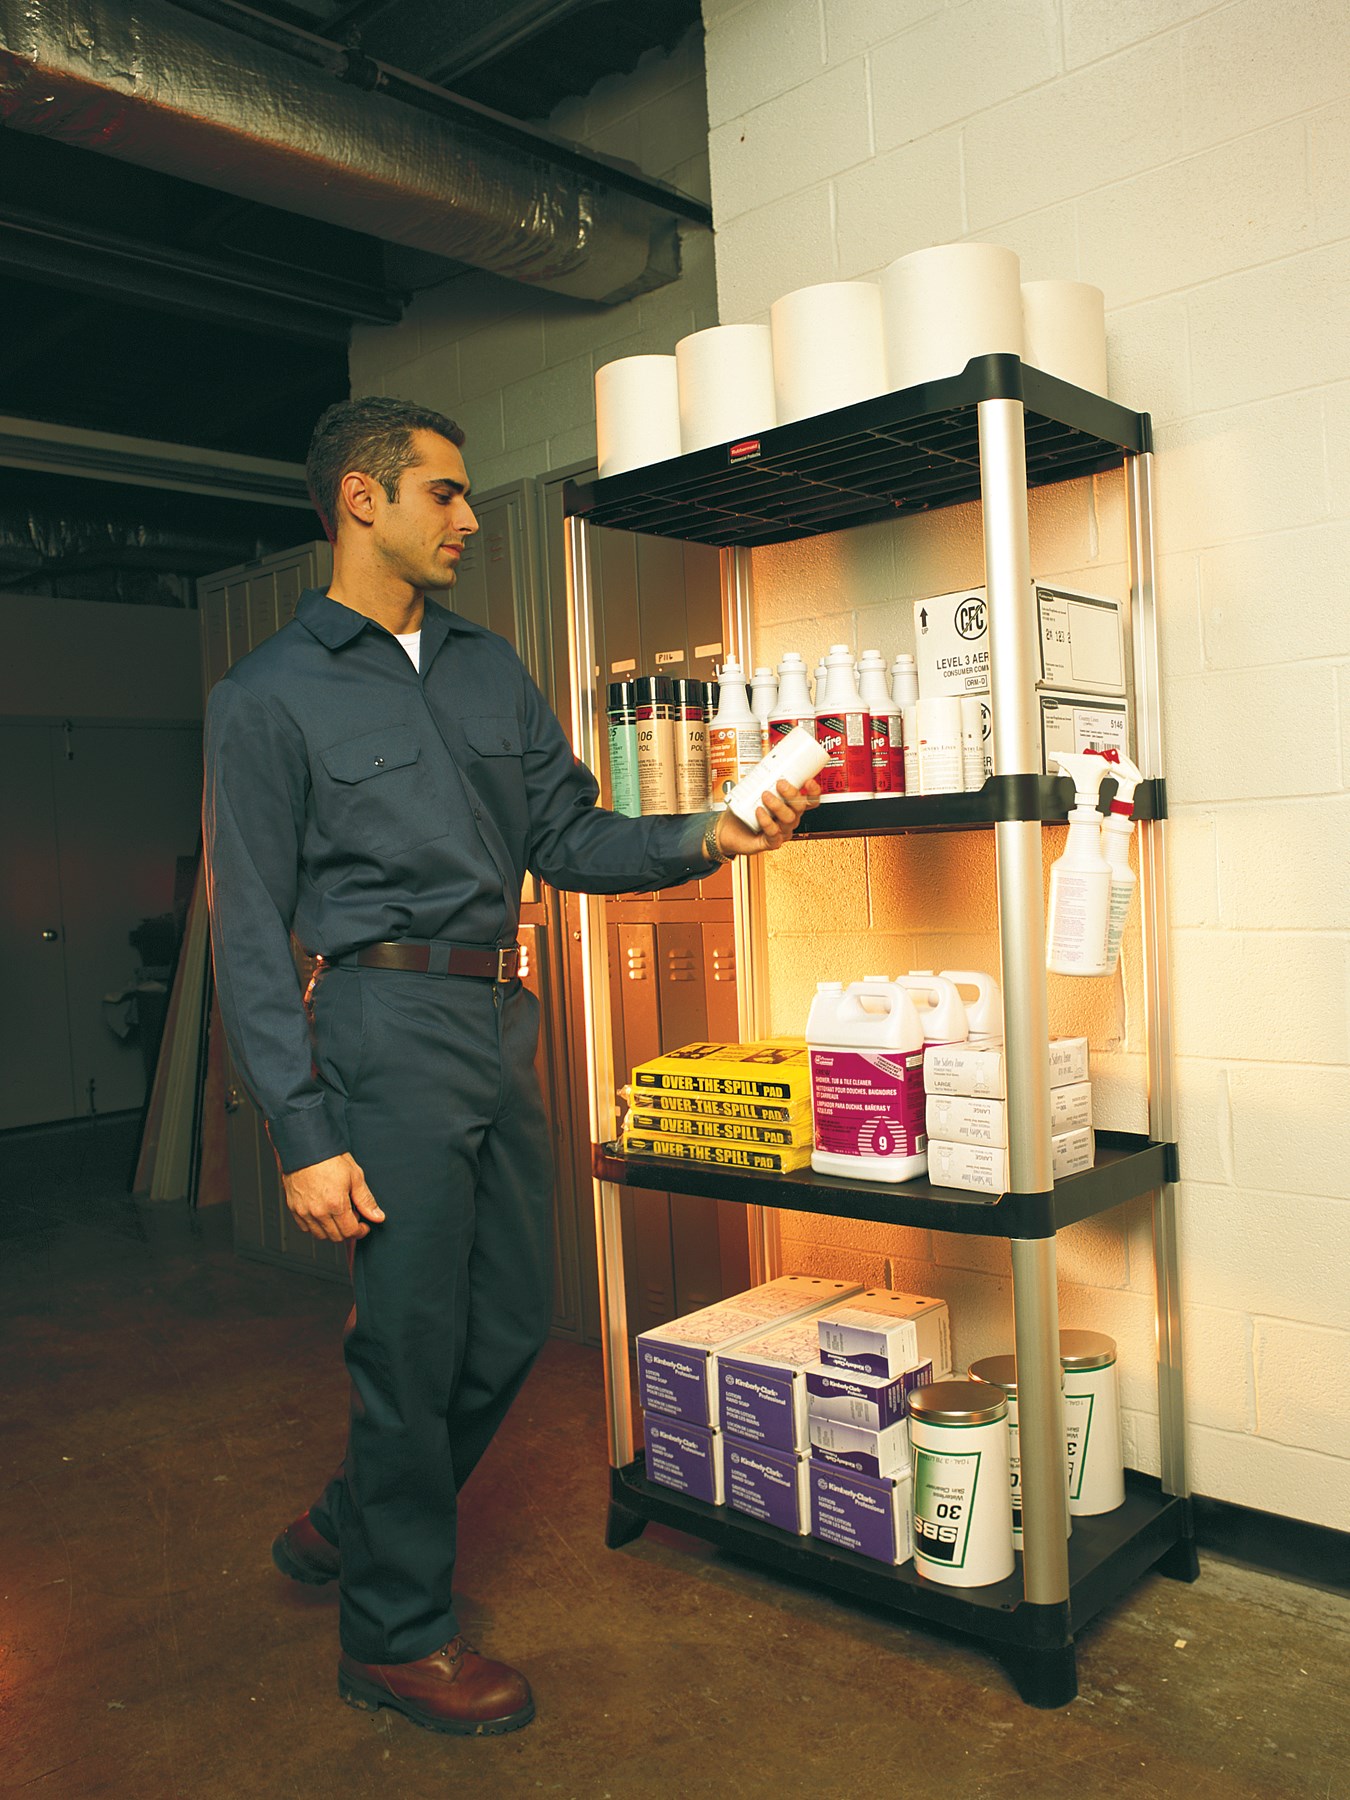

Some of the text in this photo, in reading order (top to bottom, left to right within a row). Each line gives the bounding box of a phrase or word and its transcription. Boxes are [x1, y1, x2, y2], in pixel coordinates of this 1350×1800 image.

[961, 605, 984, 632] CFC
[936, 651, 989, 670] LEVEL 3 AER
[944, 667, 973, 678] CONSUMER
[967, 678, 985, 687] ORM-D
[1110, 719, 1123, 730] 5146
[662, 1074, 783, 1098] OVER-THE-SPILL PAD
[660, 1096, 782, 1121] OVER-THE-SPILL PAD
[659, 1118, 784, 1144] OVER-THE-SPILL PAD
[879, 1136, 888, 1150] 9
[653, 1141, 774, 1169] OVER-THE-SPILL PAD
[735, 1378, 778, 1396] Kimberly-Clark
[1067, 1442, 1077, 1456] 3
[828, 1482, 875, 1504] Kimberly-Clark
[933, 1492, 964, 1501] Waterless
[854, 1499, 885, 1514] Professional
[936, 1504, 962, 1520] 30
[914, 1516, 958, 1543] SBS
